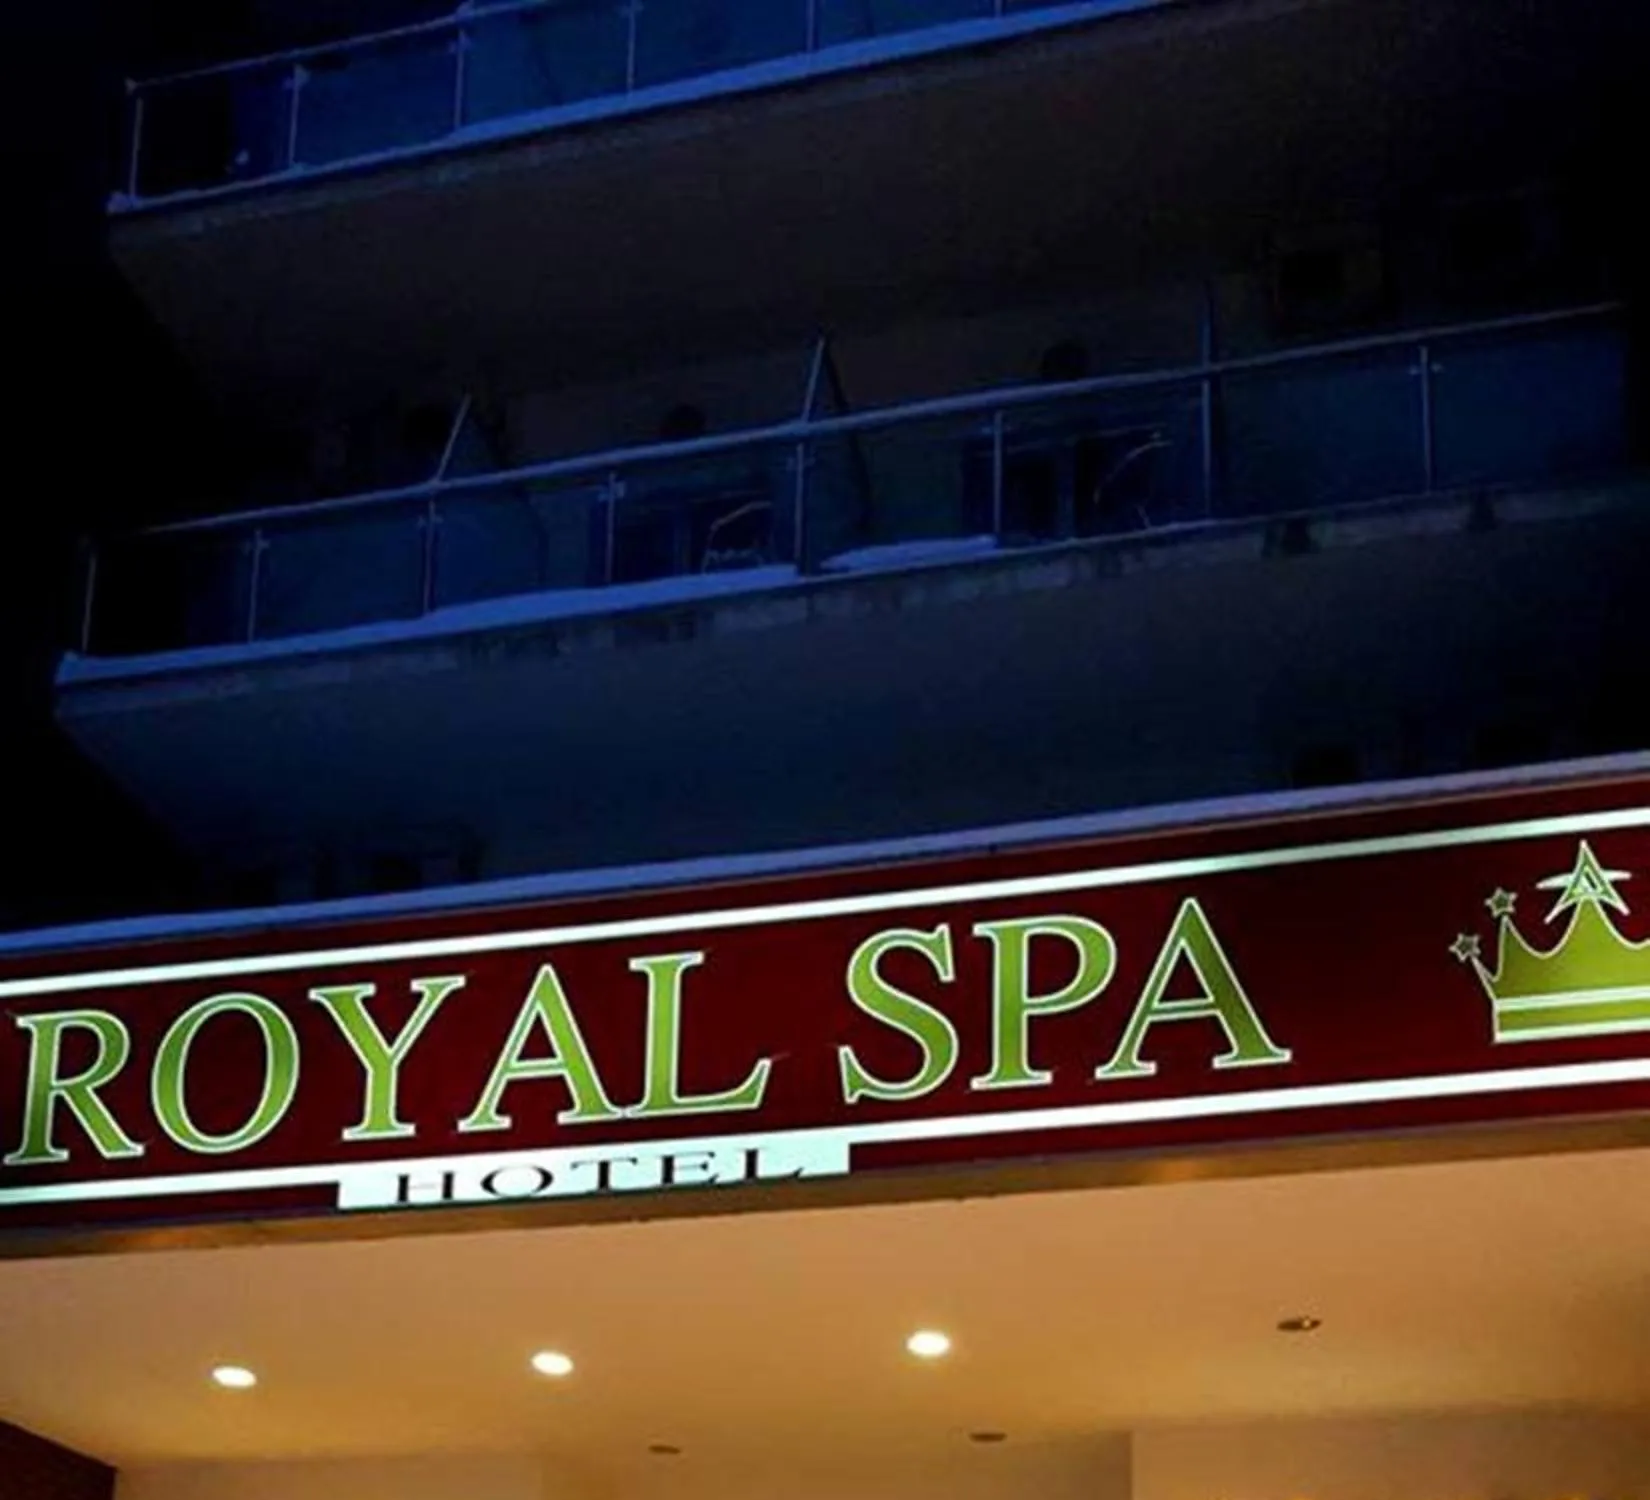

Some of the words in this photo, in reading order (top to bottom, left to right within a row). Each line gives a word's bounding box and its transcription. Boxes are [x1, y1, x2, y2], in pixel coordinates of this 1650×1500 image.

[4, 951, 772, 1165] ROYAL
[838, 896, 1293, 1104] SPA
[396, 1146, 804, 1204] HOTEL
